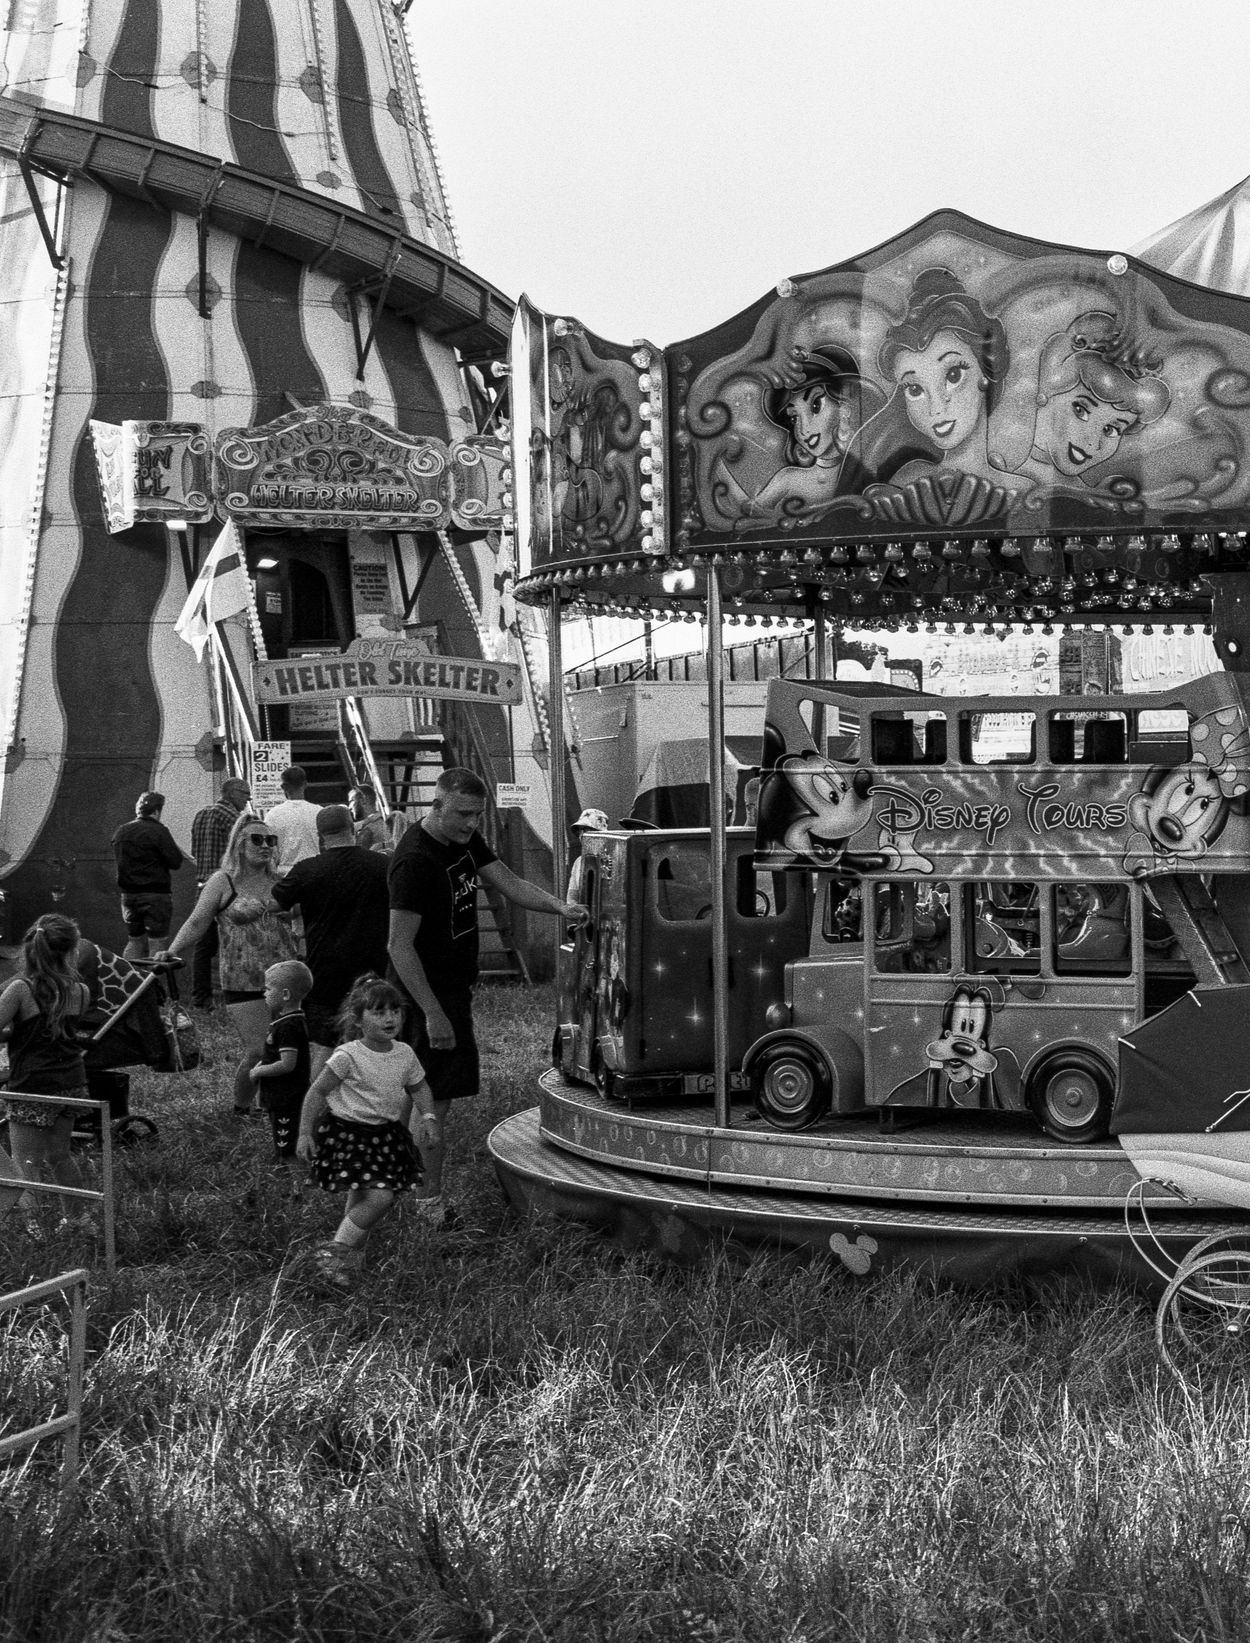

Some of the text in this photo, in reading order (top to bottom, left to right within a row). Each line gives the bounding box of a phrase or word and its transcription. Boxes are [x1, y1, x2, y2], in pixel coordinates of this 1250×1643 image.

[251, 484, 420, 512] HELTER SKELTER
[275, 660, 501, 697] HELTER SKELTER
[257, 742, 285, 750] FARE
[254, 762, 289, 772] SLIDES
[499, 784, 515, 792] CASH
